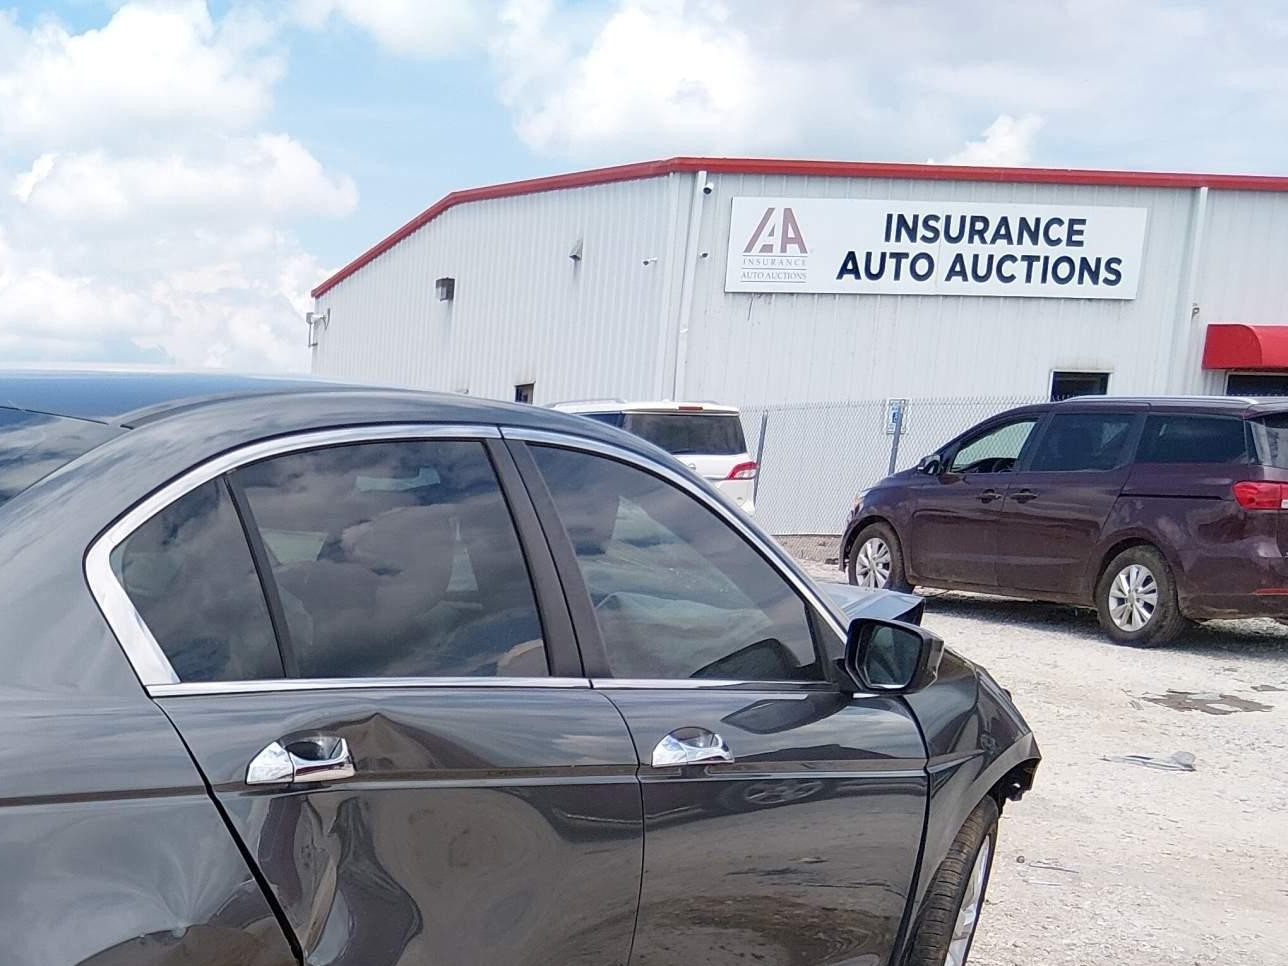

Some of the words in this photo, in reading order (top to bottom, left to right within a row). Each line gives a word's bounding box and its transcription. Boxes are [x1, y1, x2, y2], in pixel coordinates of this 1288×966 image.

[884, 213, 1087, 248] INSURANCE
[743, 257, 807, 267] INSURANCE
[836, 251, 935, 282] AUTO
[944, 253, 1123, 287] AUCTIONS
[740, 270, 764, 280] AUTO
[764, 270, 808, 281] AUCTIONS
